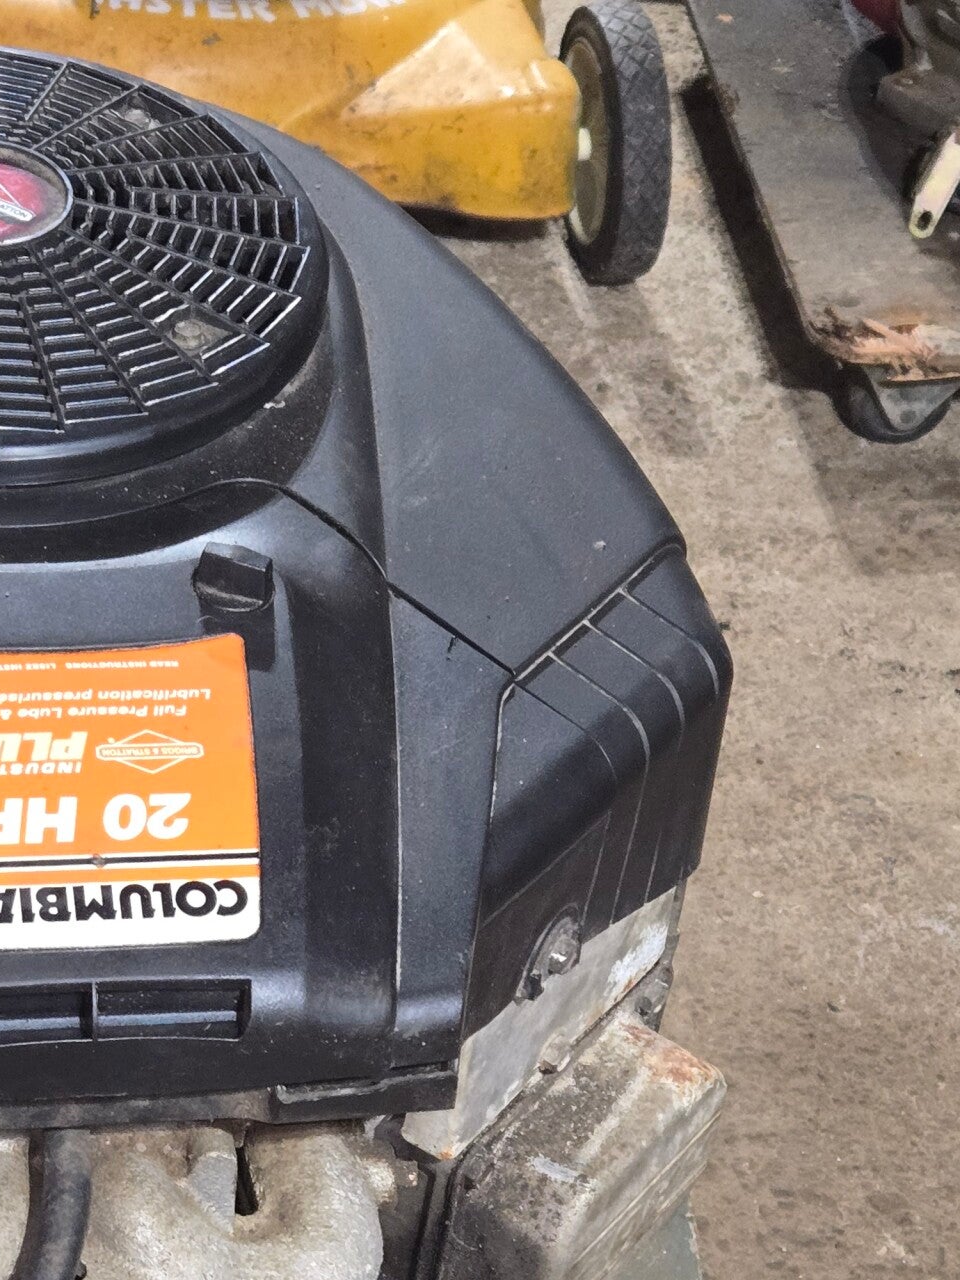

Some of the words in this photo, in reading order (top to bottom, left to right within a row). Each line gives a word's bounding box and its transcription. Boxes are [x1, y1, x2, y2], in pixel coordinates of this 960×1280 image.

[65, 661, 147, 669] INSTRUCTIONS
[97, 688, 211, 701] Lubrification
[0, 708, 12, 721] &
[17, 707, 63, 720] Lube
[67, 705, 149, 718] Pressure
[153, 704, 187, 717] Full
[101, 748, 151, 757] STRATTON
[102, 792, 192, 842] 20
